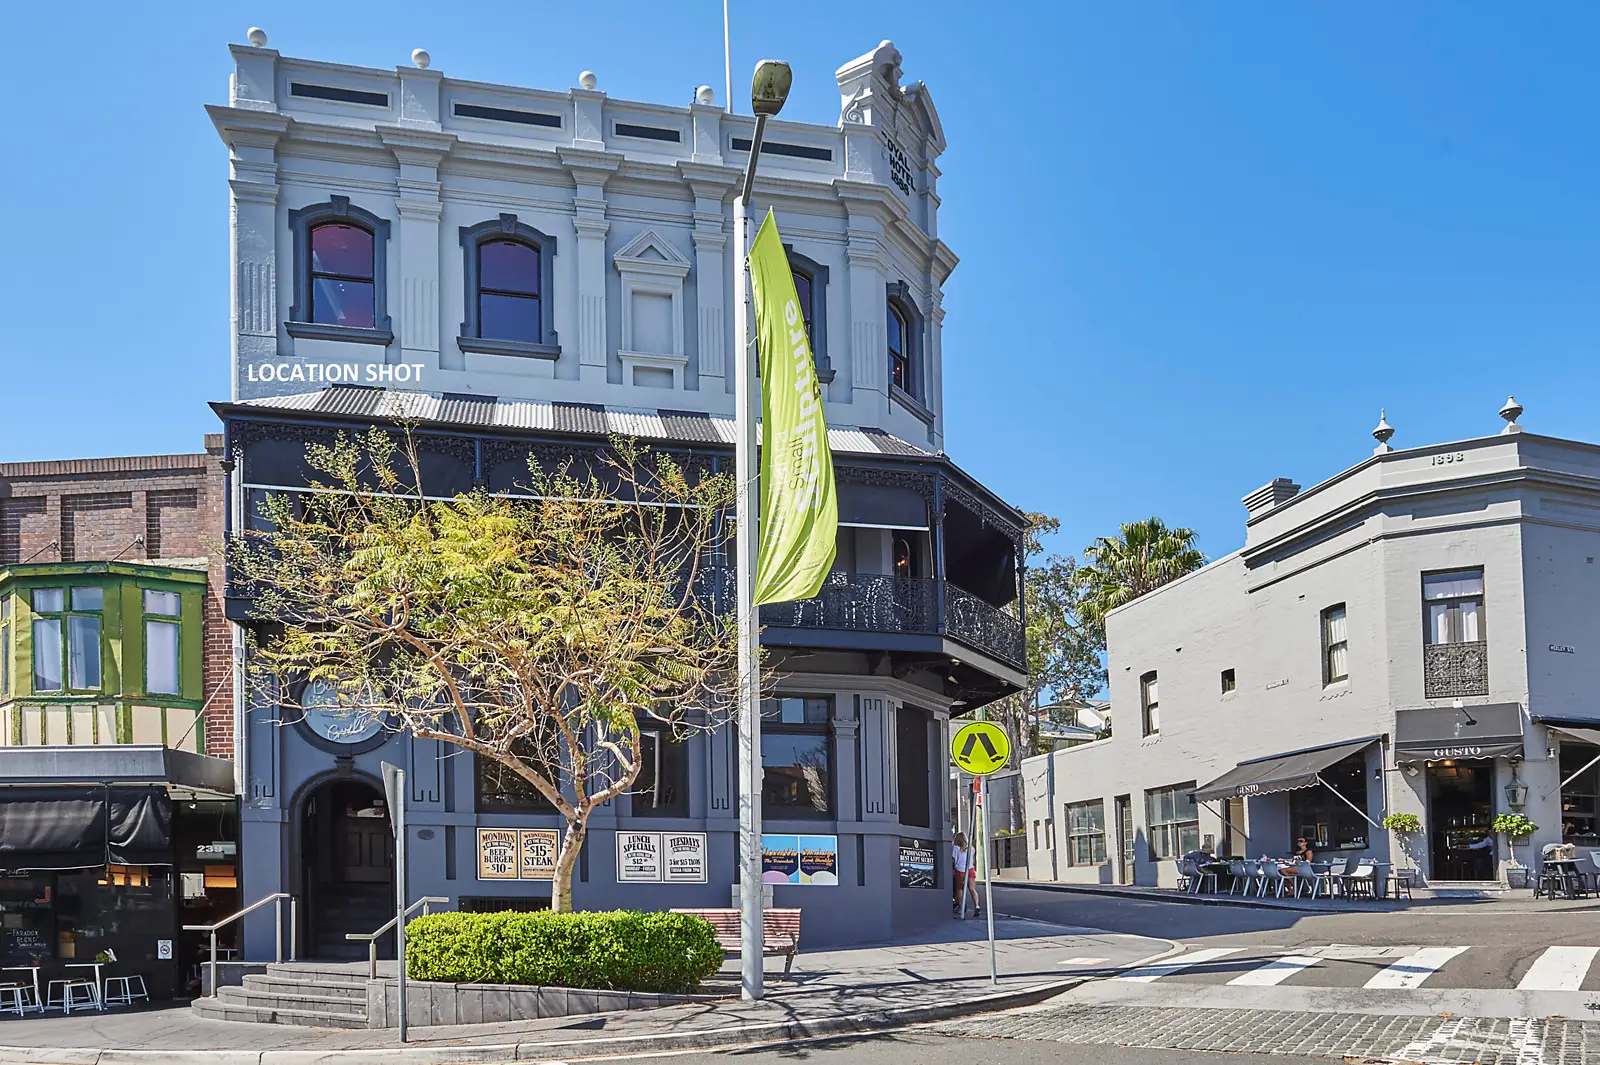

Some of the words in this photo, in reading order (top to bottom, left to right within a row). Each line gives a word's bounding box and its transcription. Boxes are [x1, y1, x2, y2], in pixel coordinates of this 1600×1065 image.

[890, 153, 916, 192] HOTEL
[891, 169, 910, 196] 1888
[783, 299, 820, 512] Sculpture
[788, 437, 804, 490] Small
[1432, 453, 1464, 466] 1898
[1434, 747, 1481, 757] GUSTO
[1236, 784, 1259, 794] GUSTO
[482, 832, 515, 843] MONDAYS
[628, 835, 650, 844] LUNCH
[670, 837, 700, 848] TUESDAYS
[623, 843, 656, 853] SPECIALS
[524, 856, 553, 866] STEAK
